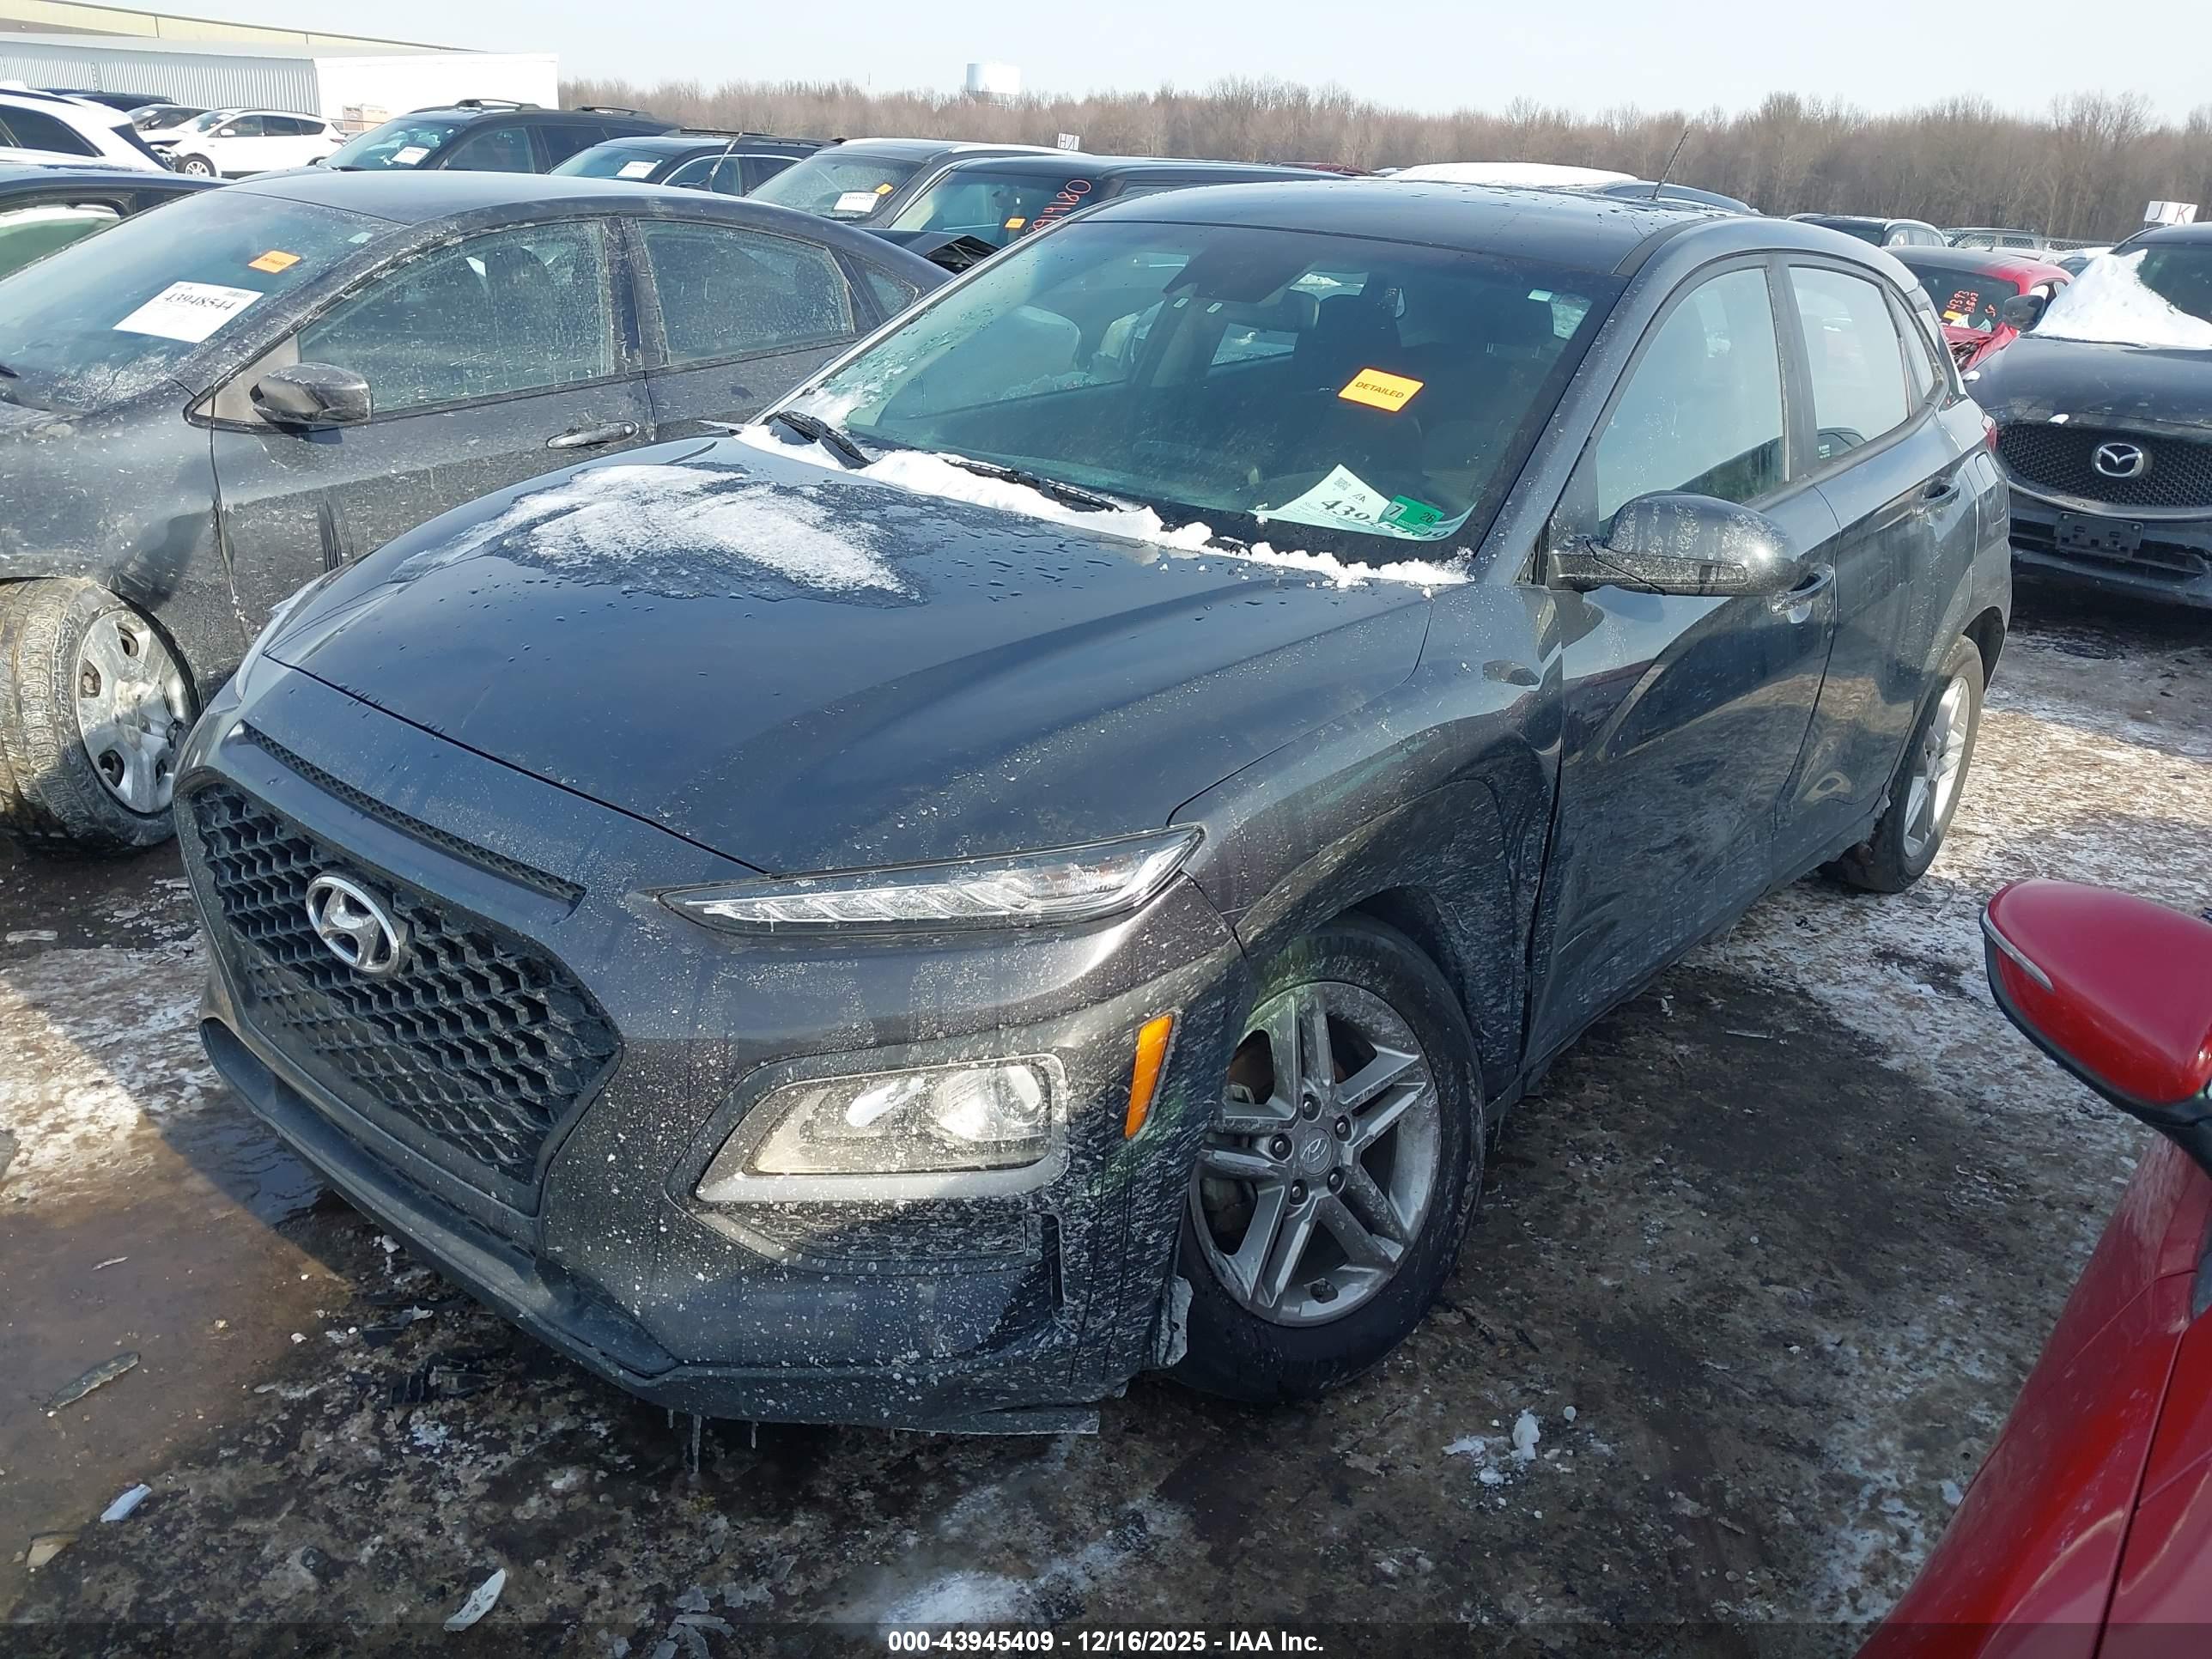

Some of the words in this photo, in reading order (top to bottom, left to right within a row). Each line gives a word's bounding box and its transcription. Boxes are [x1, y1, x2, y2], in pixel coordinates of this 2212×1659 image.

[2151, 202, 2165, 221] J
[2173, 204, 2191, 225] K
[164, 292, 237, 311] 43948544
[1354, 380, 1405, 399] DETAILED
[1389, 505, 1403, 516] 7
[1419, 511, 1437, 524] 26
